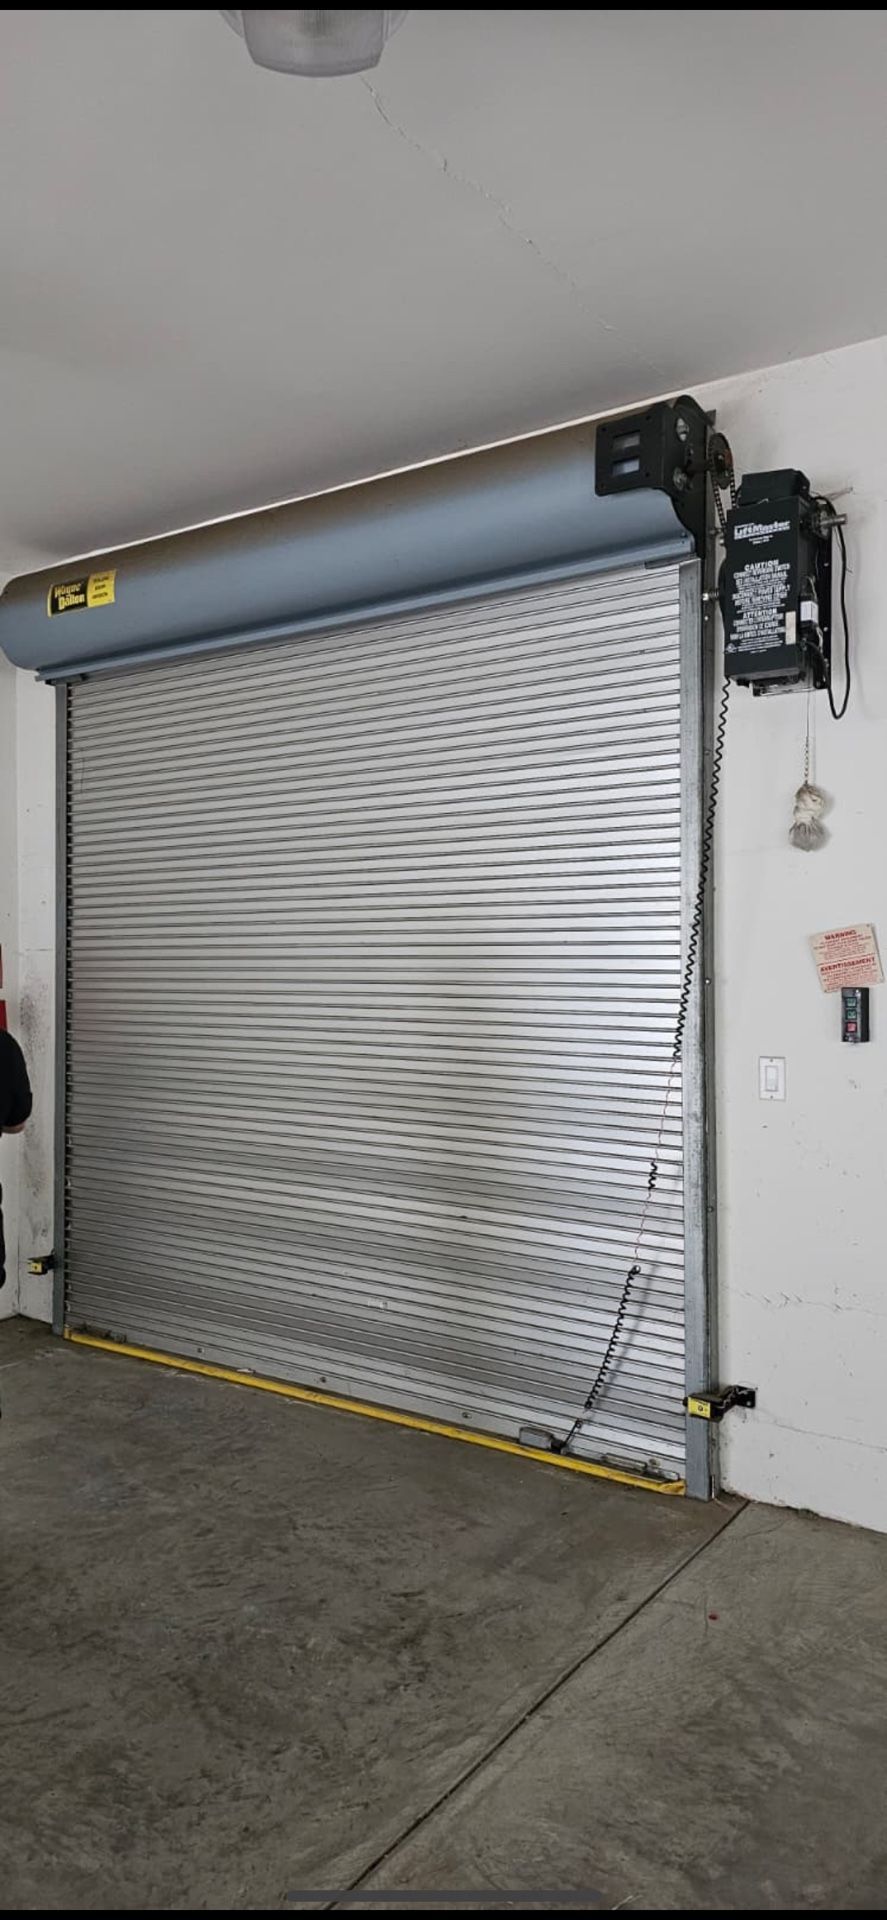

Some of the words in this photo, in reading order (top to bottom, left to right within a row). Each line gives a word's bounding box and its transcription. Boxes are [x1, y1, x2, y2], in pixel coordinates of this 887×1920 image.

[734, 521, 791, 536] LiftMaster
[744, 559, 779, 571] CAUTION
[743, 608, 777, 619] ATTENTION
[824, 929, 857, 940] WARNING
[820, 957, 875, 972] AVERTISSEMENT
